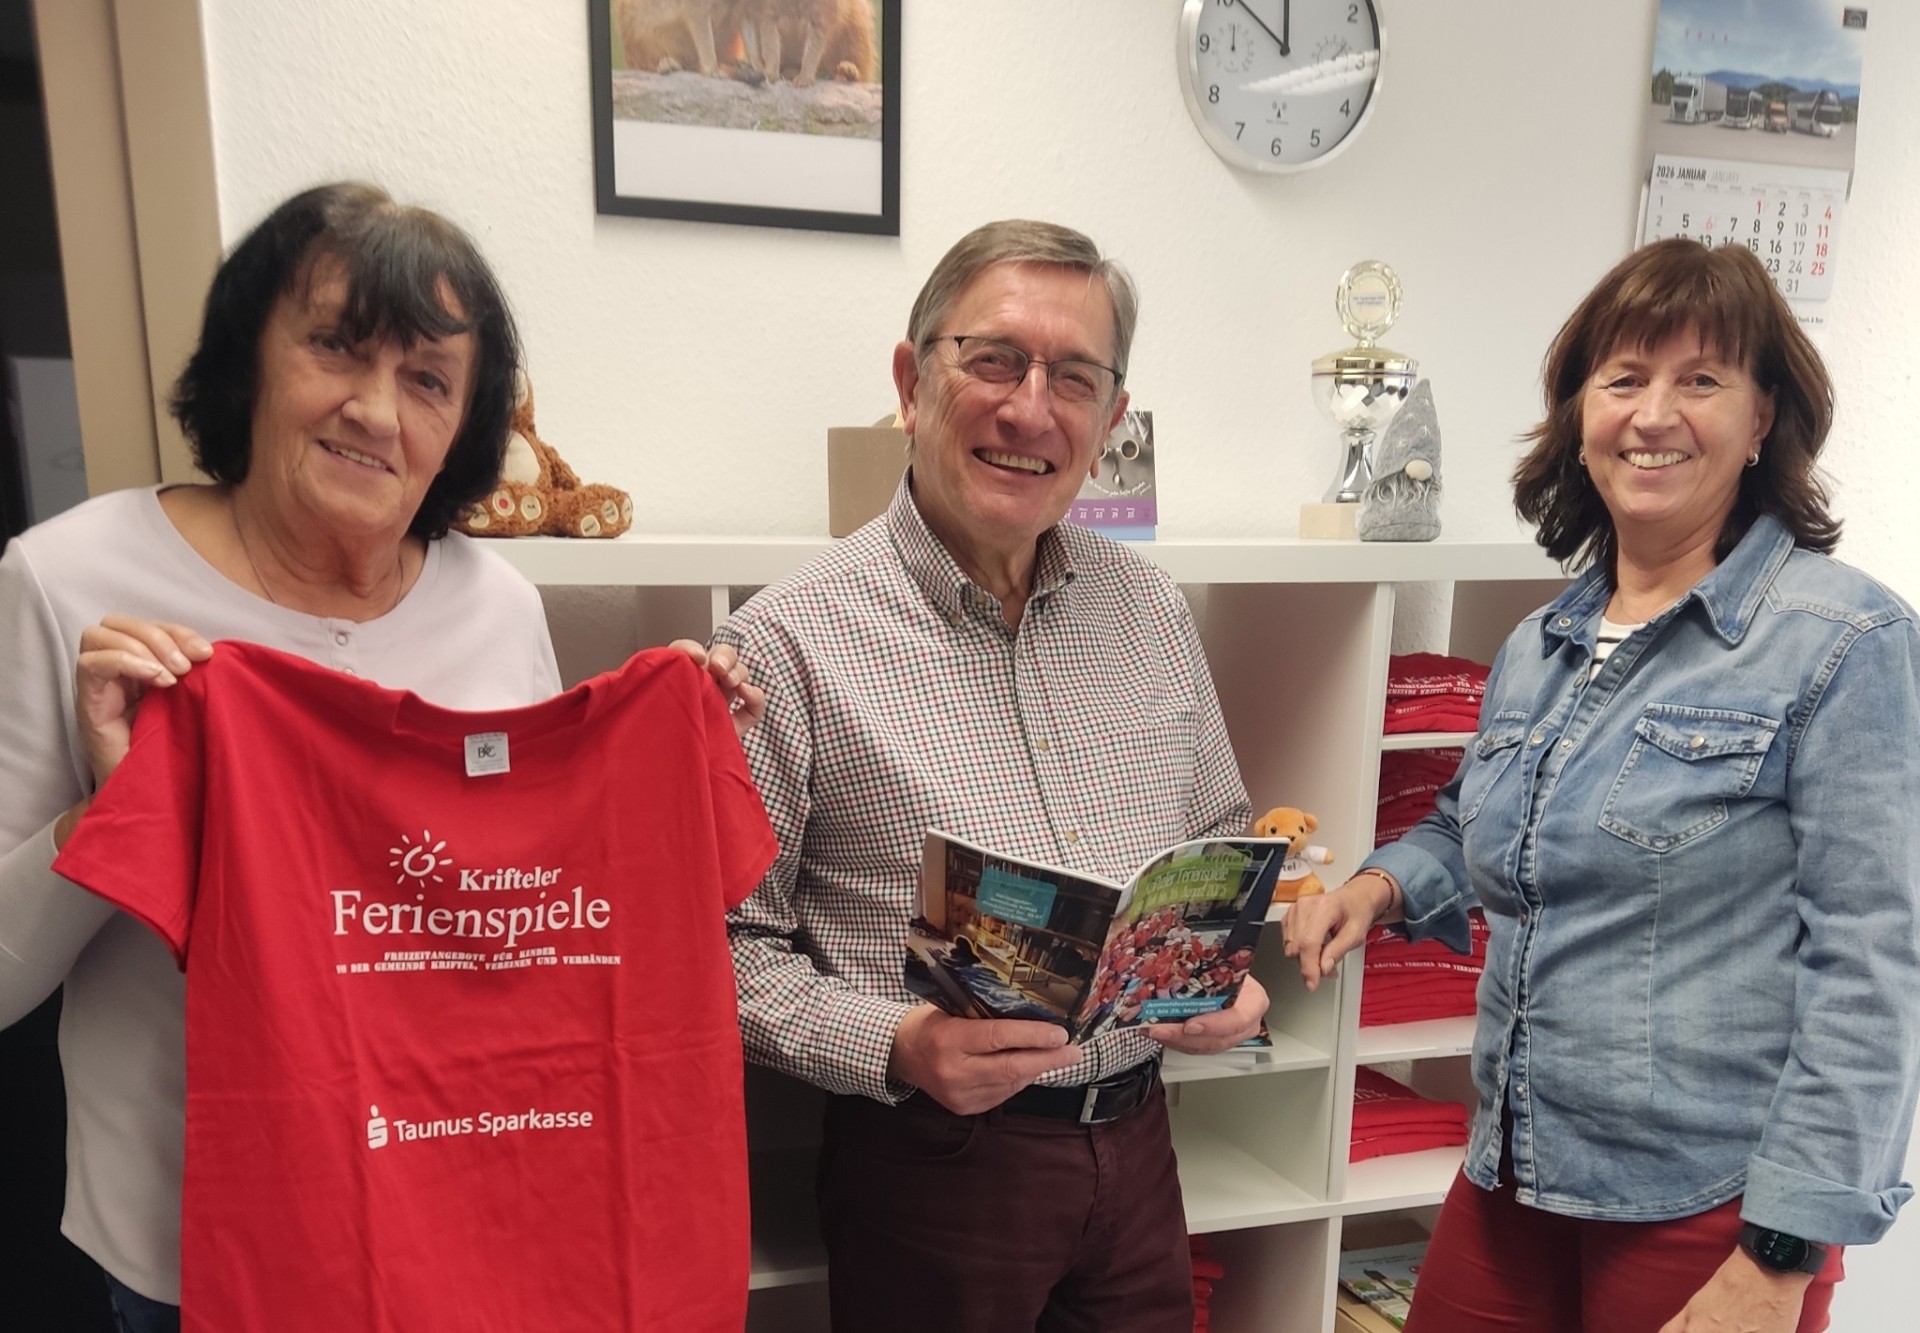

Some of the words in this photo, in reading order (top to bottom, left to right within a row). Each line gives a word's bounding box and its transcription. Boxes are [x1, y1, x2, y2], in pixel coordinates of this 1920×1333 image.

[1347, 5, 1358, 23] 2
[1199, 34, 1210, 53] 9
[1355, 52, 1365, 71] 3
[1208, 84, 1220, 104] 8
[1339, 98, 1351, 117] 4
[1235, 121, 1246, 141] 7
[1310, 129, 1321, 148] 5
[1270, 138, 1282, 157] 6
[1656, 165, 1675, 179] 2026
[1676, 167, 1707, 182] JANUAR
[1659, 195, 1664, 207] 1
[1756, 201, 1762, 214] 1
[1778, 202, 1786, 217] 2
[1801, 203, 1809, 218] 3
[1824, 206, 1832, 220] 4
[1656, 215, 1662, 227] 2
[1682, 214, 1690, 228] 5
[1706, 216, 1714, 230] 6
[1730, 217, 1738, 232] 7
[1753, 218, 1760, 233] 8
[1777, 220, 1784, 235] 9
[1794, 222, 1807, 237] 10
[1817, 224, 1829, 238] 11
[1747, 238, 1760, 252] 15
[1769, 239, 1782, 254] 16
[1792, 241, 1805, 255] 17
[1815, 243, 1828, 257] 18
[1766, 258, 1780, 273] 23
[1788, 260, 1802, 274] 24
[1811, 262, 1825, 276] 25
[1785, 279, 1798, 292] 31
[1204, 854, 1245, 864] Kriftel
[458, 866, 562, 891] Krifteler
[330, 886, 611, 948] Ferienspiele
[350, 962, 370, 973] DER
[374, 961, 426, 972] GEMEINDE
[431, 960, 478, 971] KRIFTEL,
[485, 957, 532, 971] VEREINEN
[536, 956, 558, 965] UND
[562, 953, 621, 965] VERBÄNDEN
[384, 951, 486, 962] FREIZEITANGEBOTE
[493, 952, 513, 962] FÜR
[519, 946, 556, 959] KINDER
[393, 1116, 473, 1142] Taunus
[477, 1107, 593, 1137] Sparkasse
